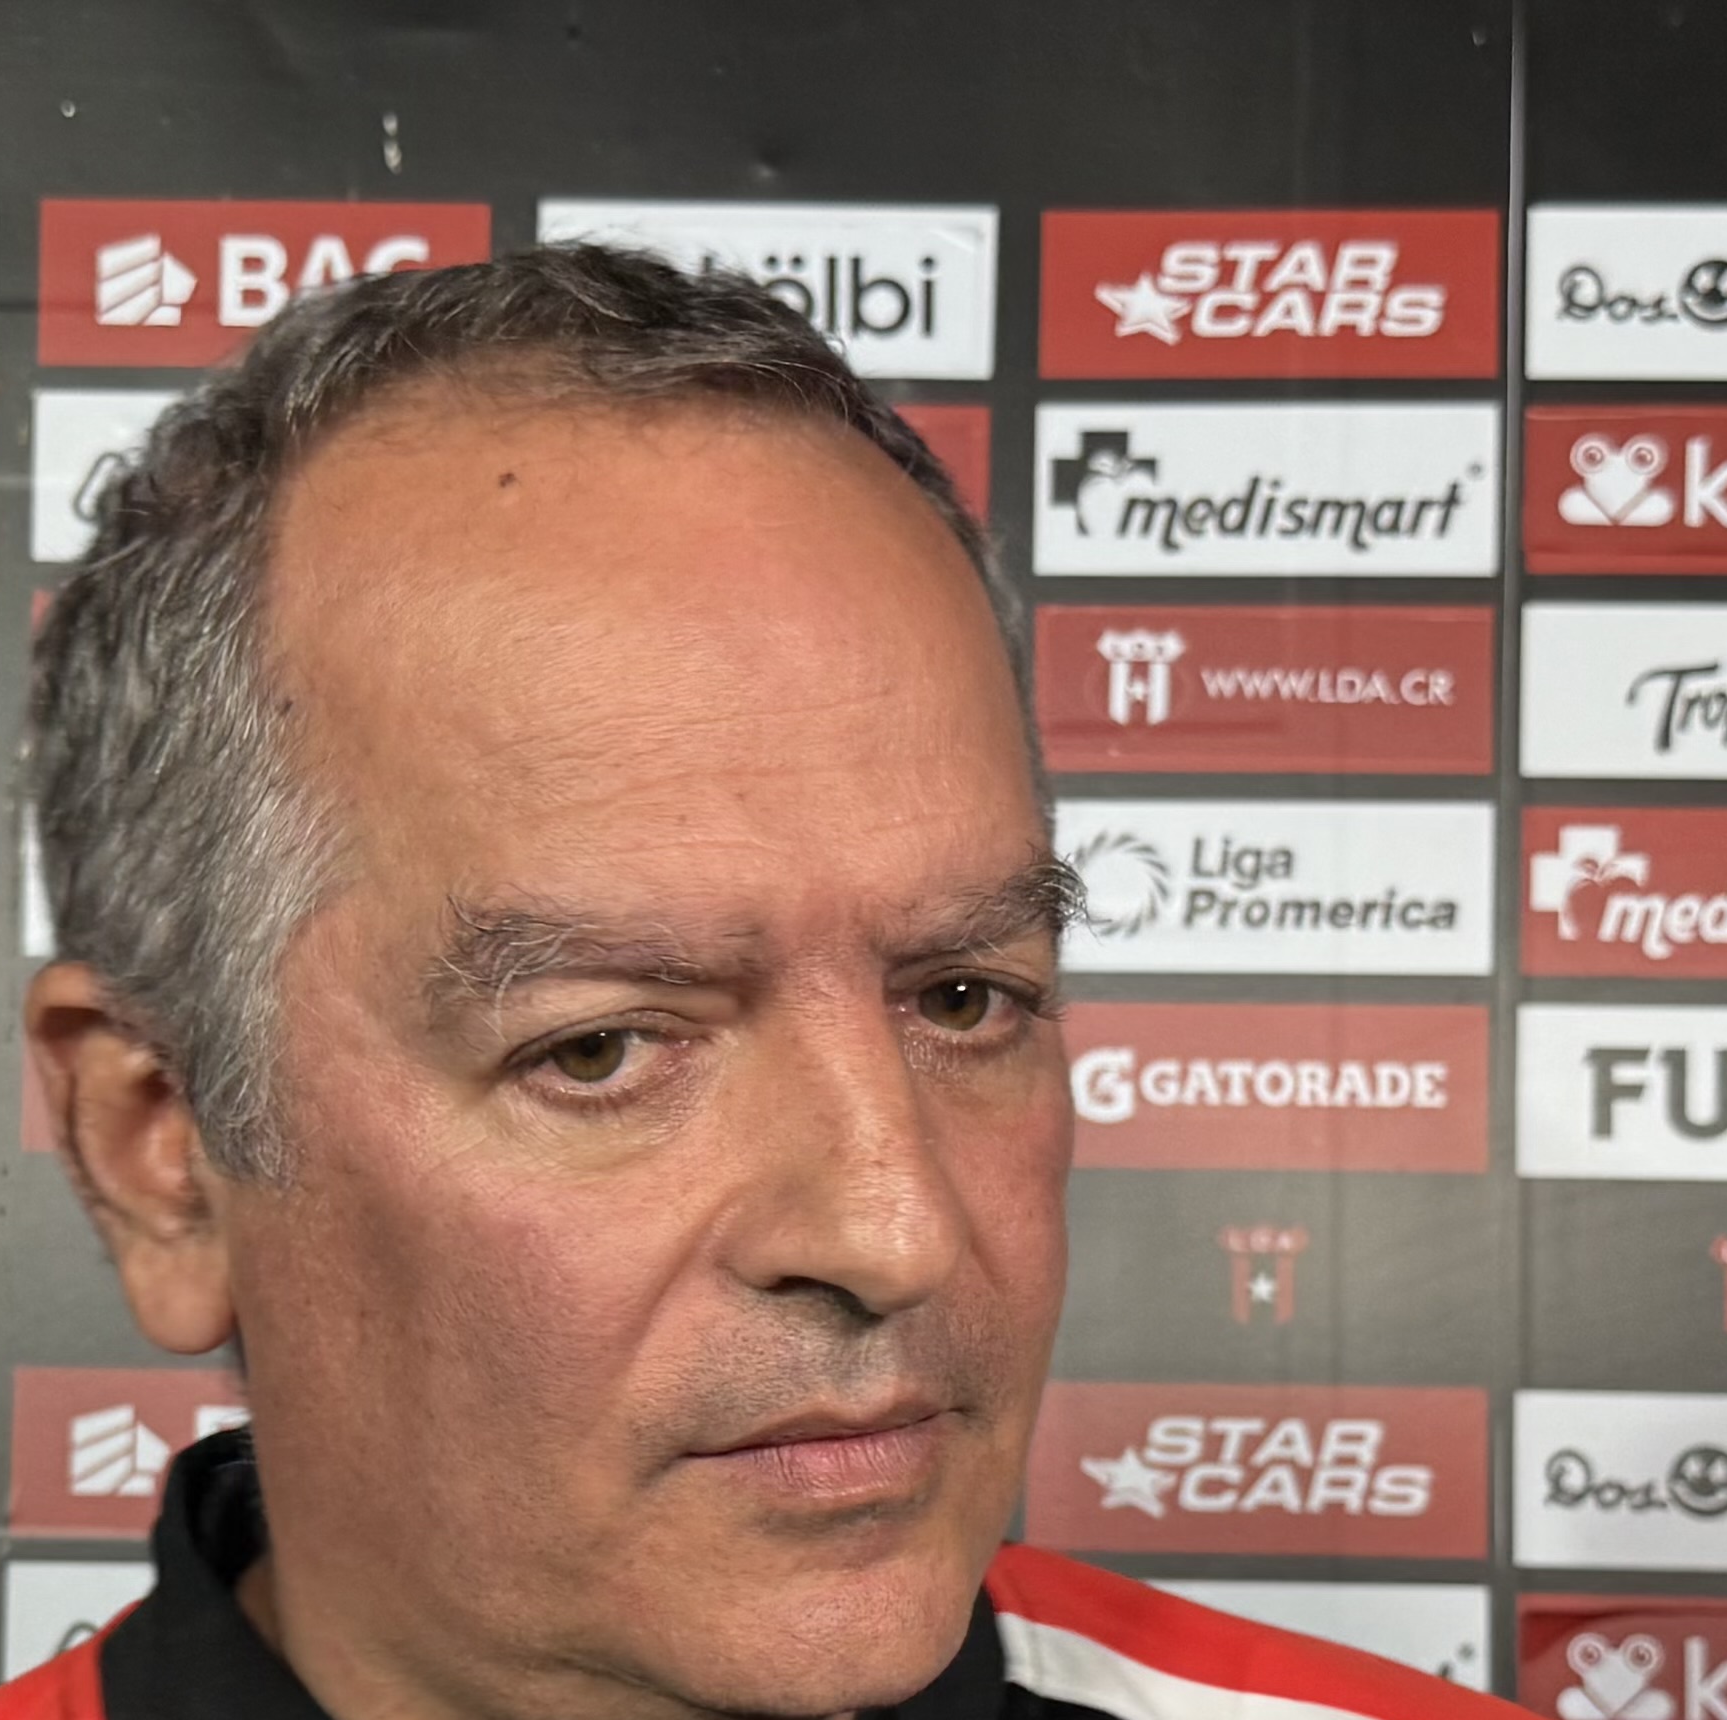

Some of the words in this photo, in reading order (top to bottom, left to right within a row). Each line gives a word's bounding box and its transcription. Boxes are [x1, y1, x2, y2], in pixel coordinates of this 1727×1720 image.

[704, 255, 936, 336] ölbi
[1153, 243, 1396, 296] STAR
[1558, 267, 1677, 323] Dos
[1192, 283, 1444, 336] CARS
[1117, 475, 1462, 553] medismart
[1201, 668, 1452, 705] WWW.LDA.CR
[1191, 837, 1295, 890] Liga
[1183, 888, 1459, 930] Promerica
[1141, 1061, 1445, 1107] GATORADE
[1144, 1417, 1383, 1473] STAR
[1179, 1459, 1432, 1514] CARS
[1546, 1450, 1668, 1507] Dos
